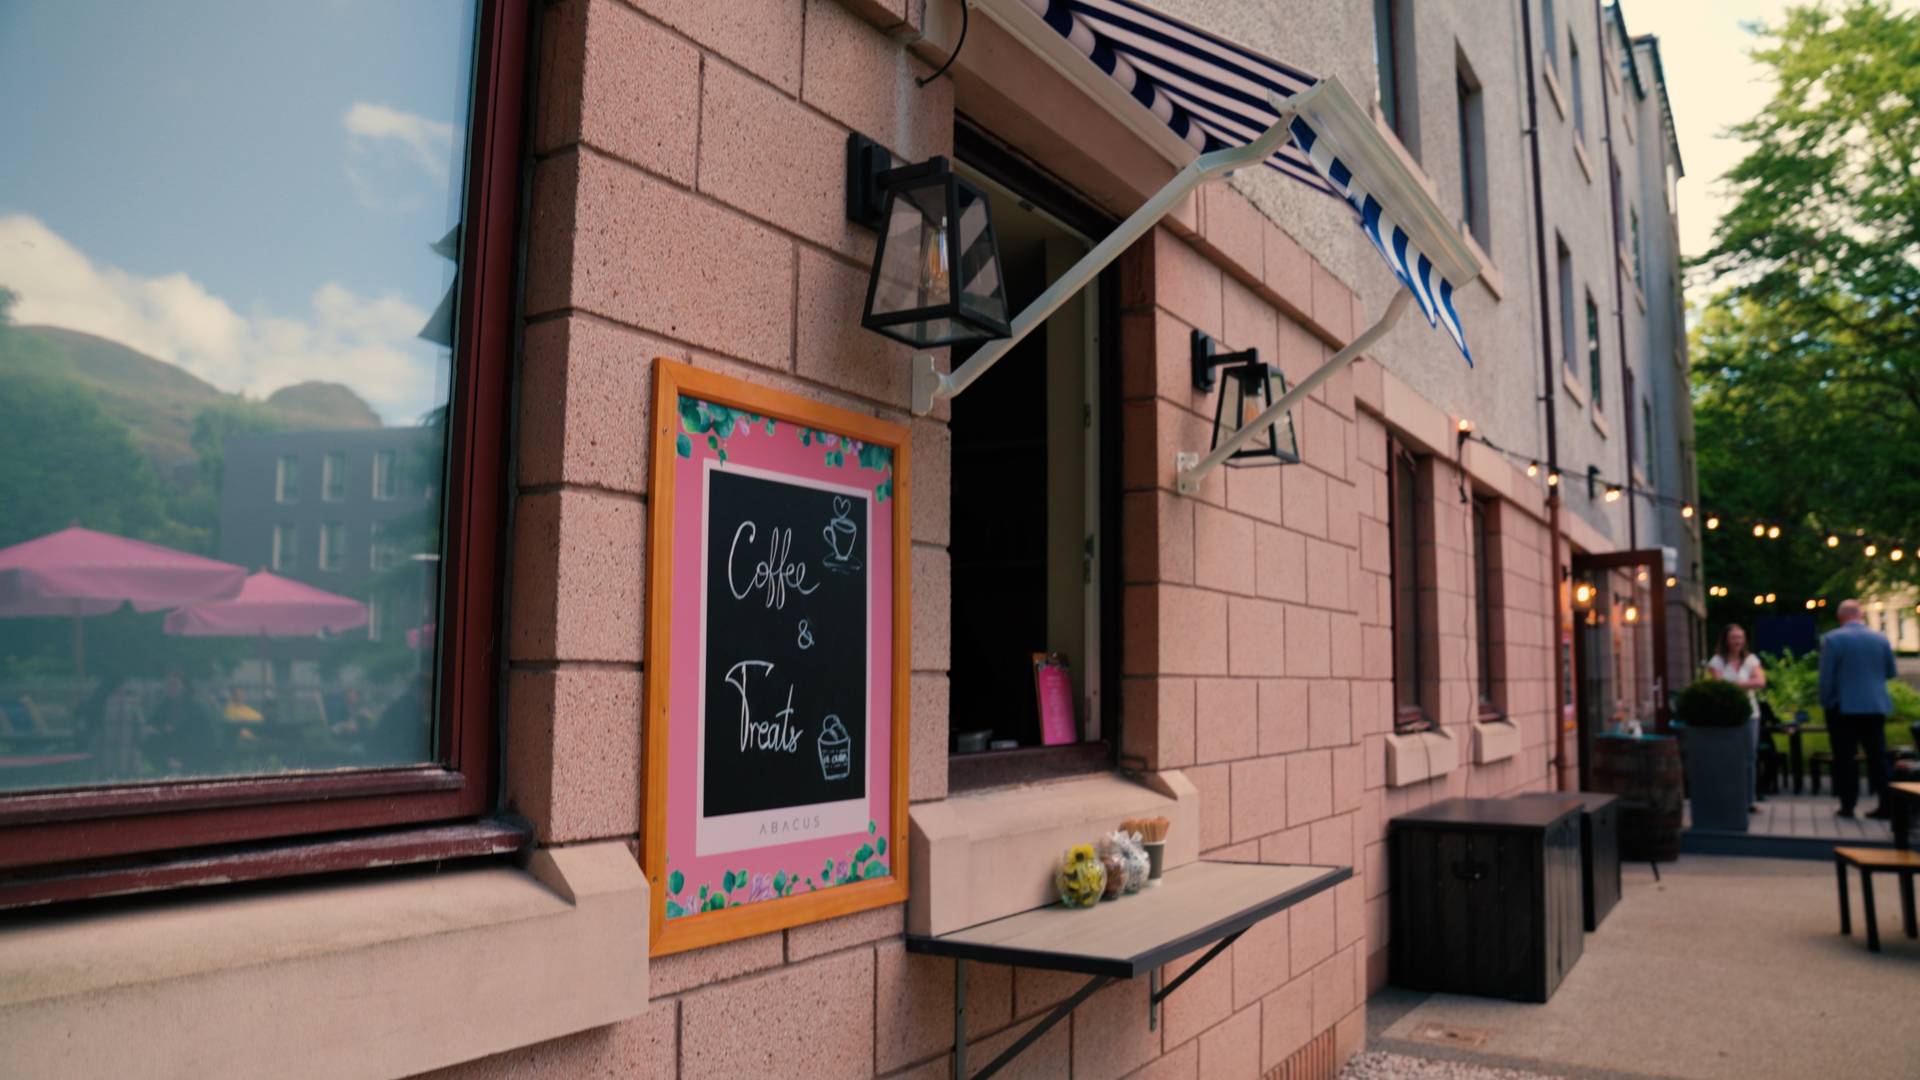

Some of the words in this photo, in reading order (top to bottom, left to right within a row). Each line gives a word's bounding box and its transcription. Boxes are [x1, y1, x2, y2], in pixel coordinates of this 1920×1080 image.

[728, 520, 820, 610] Coffee
[797, 618, 815, 650] &
[725, 660, 804, 753] Treats
[759, 815, 821, 835] ABACUS
